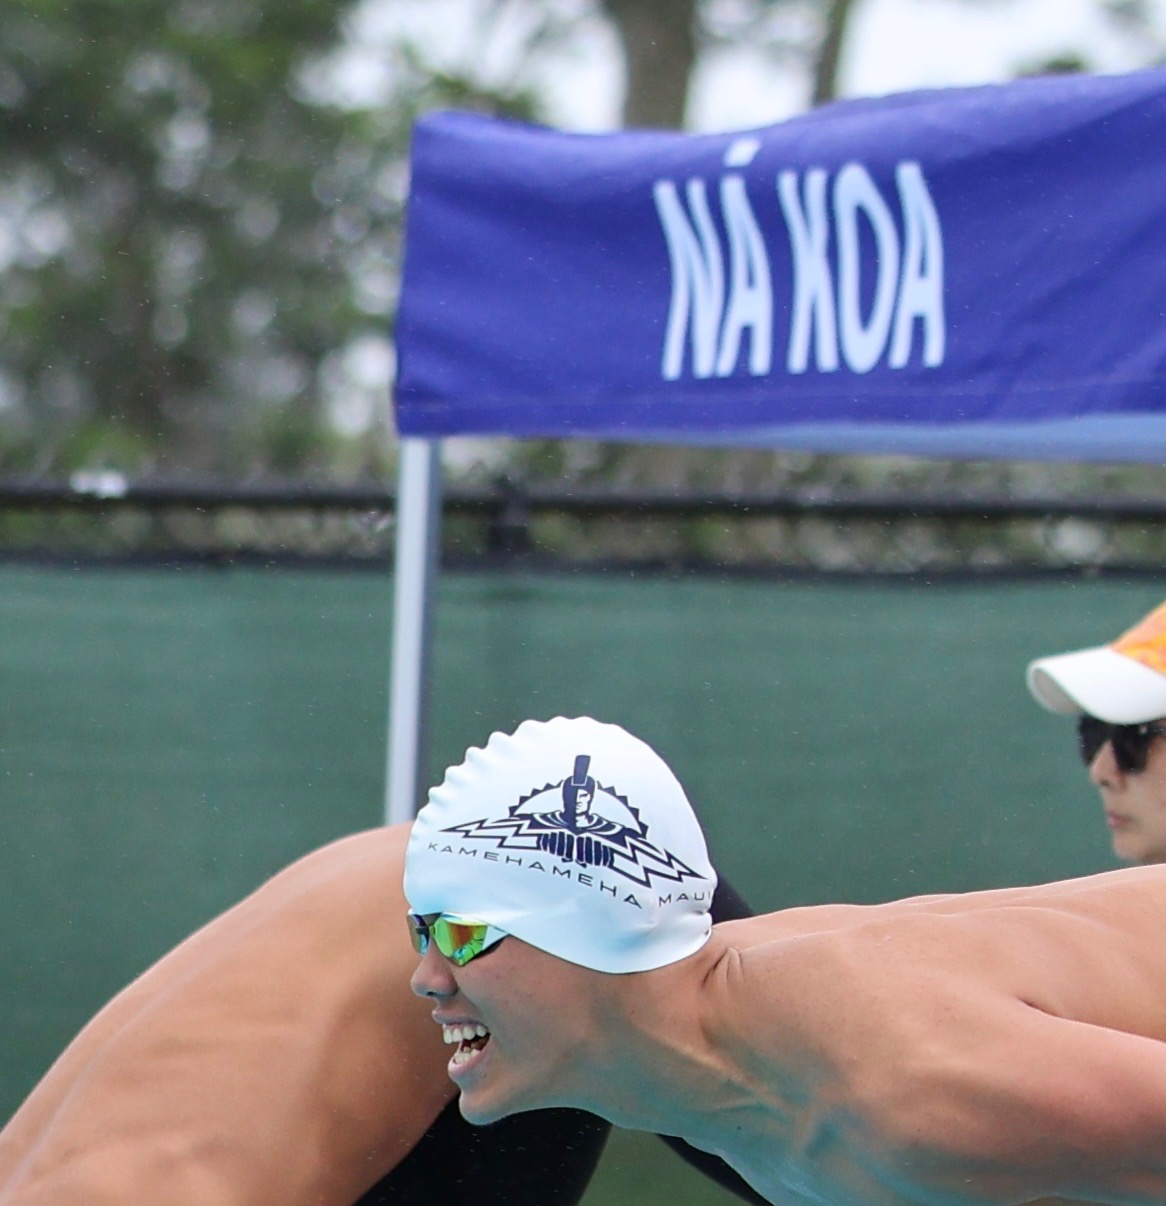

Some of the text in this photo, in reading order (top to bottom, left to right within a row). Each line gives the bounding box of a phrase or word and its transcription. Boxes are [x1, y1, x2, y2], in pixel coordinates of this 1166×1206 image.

[777, 160, 946, 375] KOA
[428, 842, 712, 910] KAMEHAMEHA MAUI
